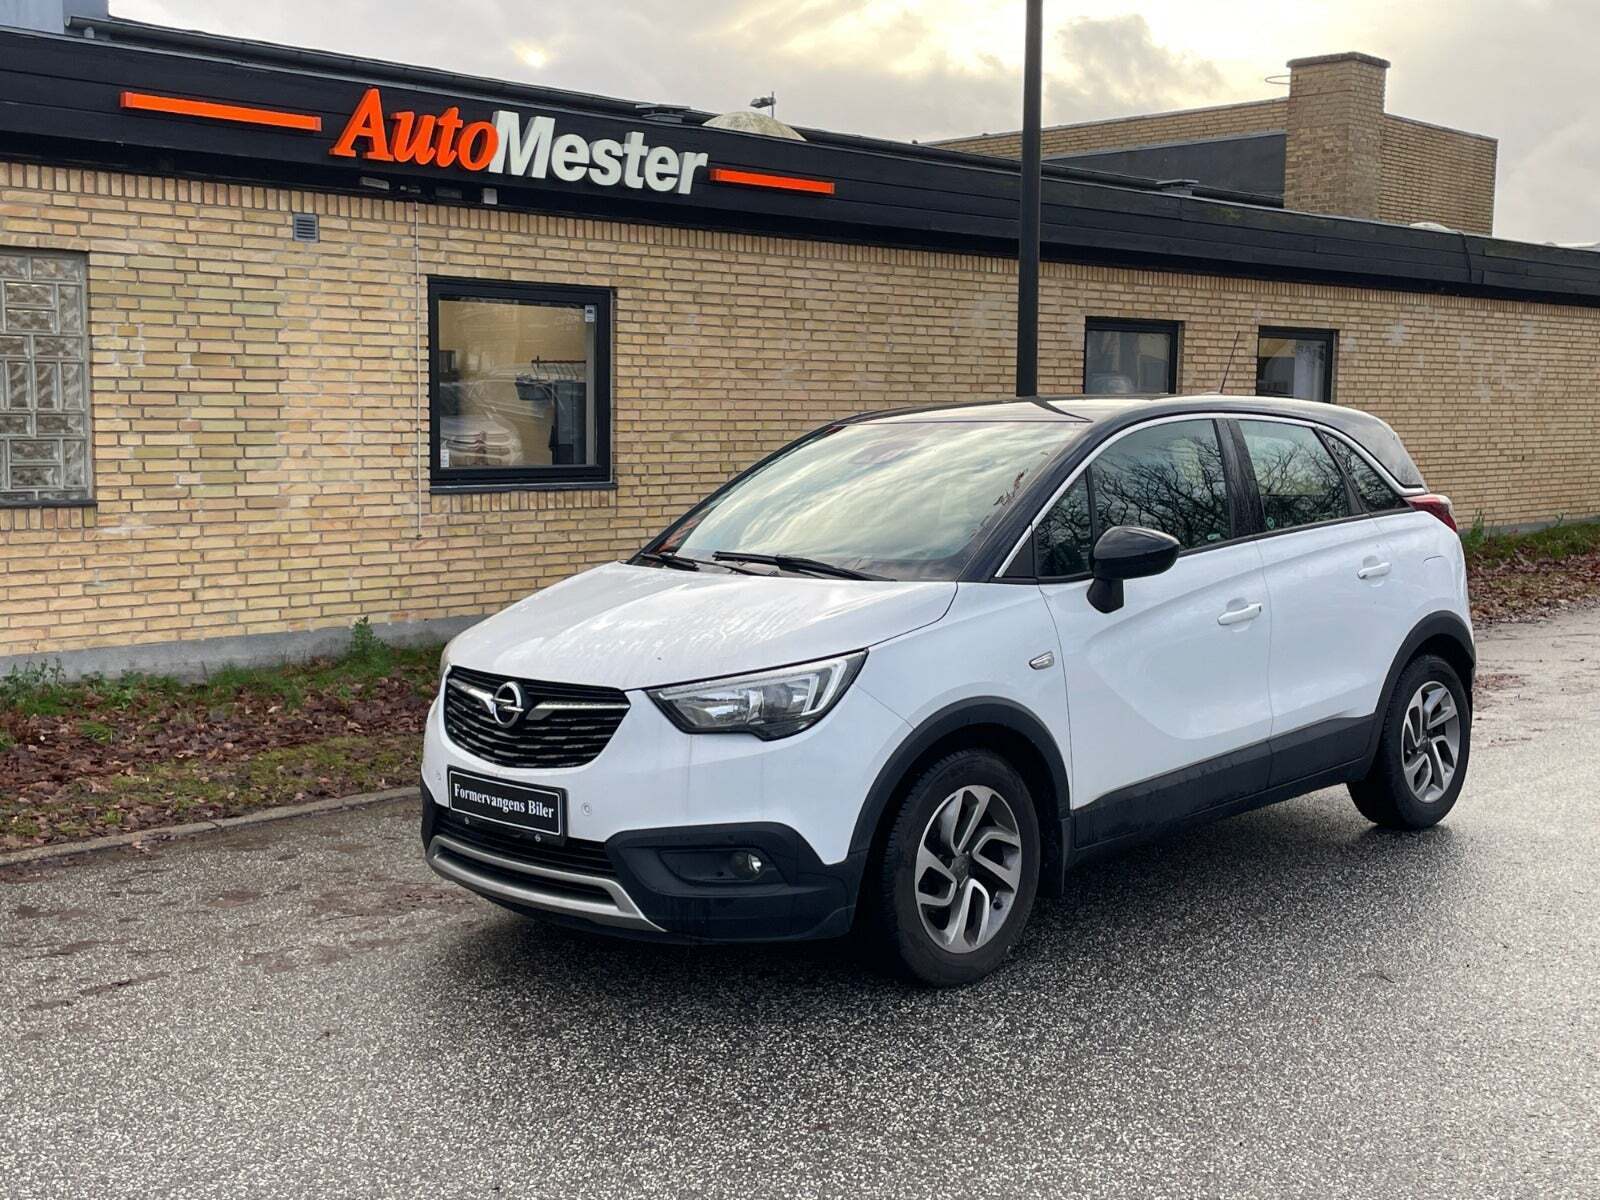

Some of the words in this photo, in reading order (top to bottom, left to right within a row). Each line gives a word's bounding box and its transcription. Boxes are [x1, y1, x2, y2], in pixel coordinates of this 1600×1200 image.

[329, 87, 709, 195] AutoMester
[454, 783, 525, 814] Formervangens
[528, 800, 555, 819] Biler
